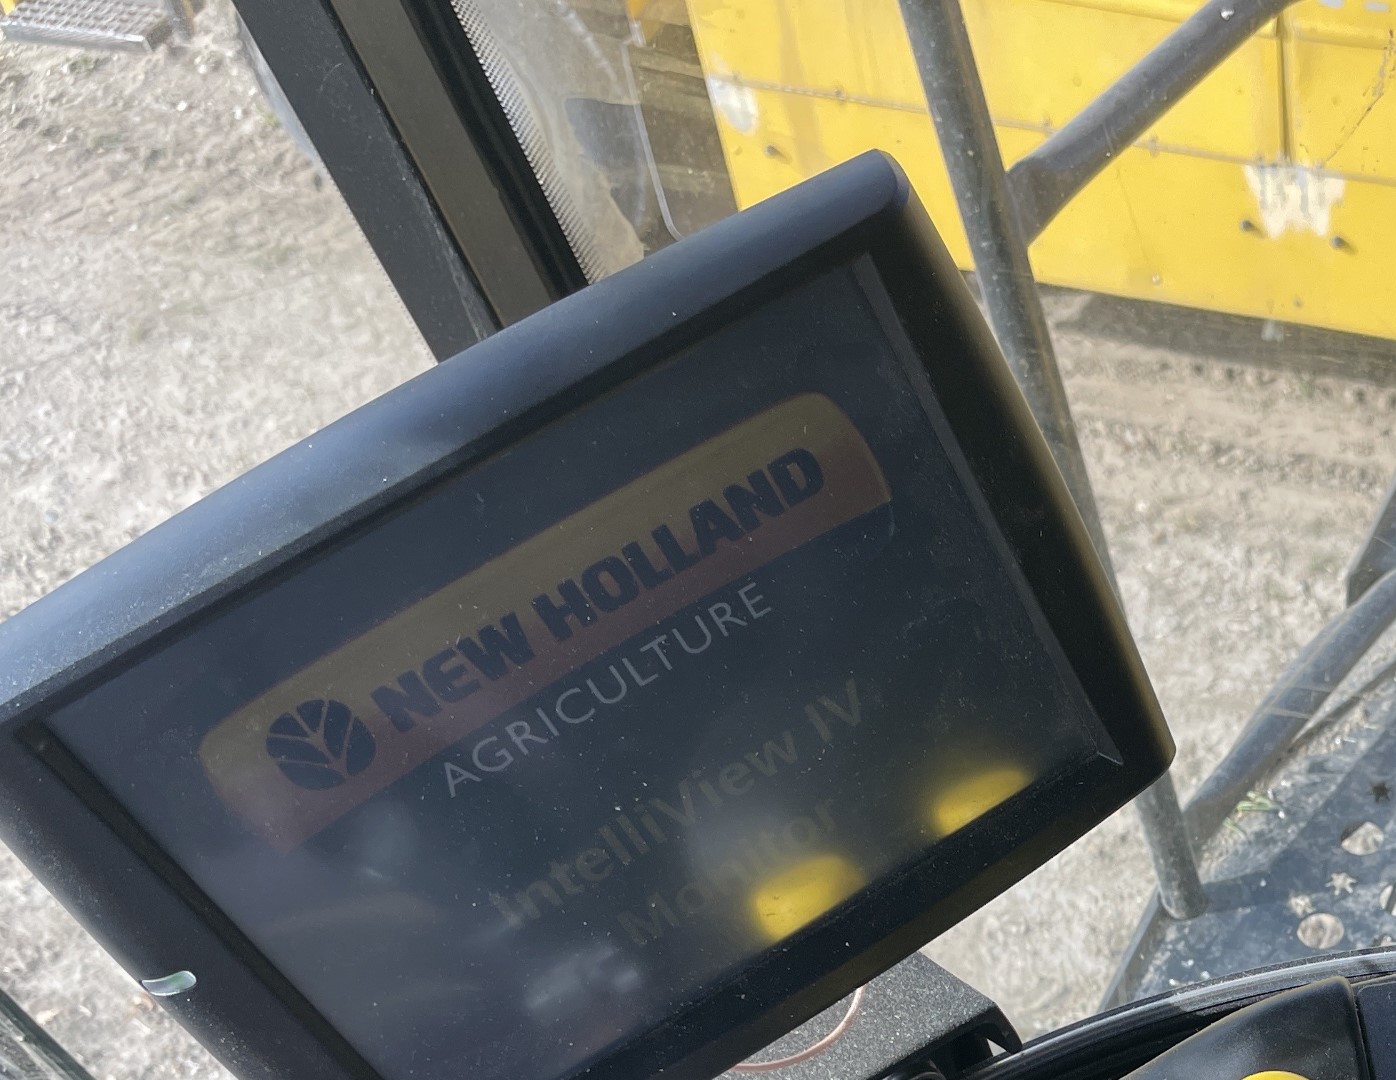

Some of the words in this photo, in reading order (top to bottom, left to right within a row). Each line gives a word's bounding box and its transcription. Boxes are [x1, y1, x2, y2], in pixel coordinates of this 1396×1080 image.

[371, 613, 536, 733] NEW
[533, 447, 824, 642] HOLLAND
[442, 582, 773, 798] AGRICULTURE
[489, 730, 799, 930] IntelliView
[804, 679, 862, 742] IV
[617, 802, 840, 945] Monitor
